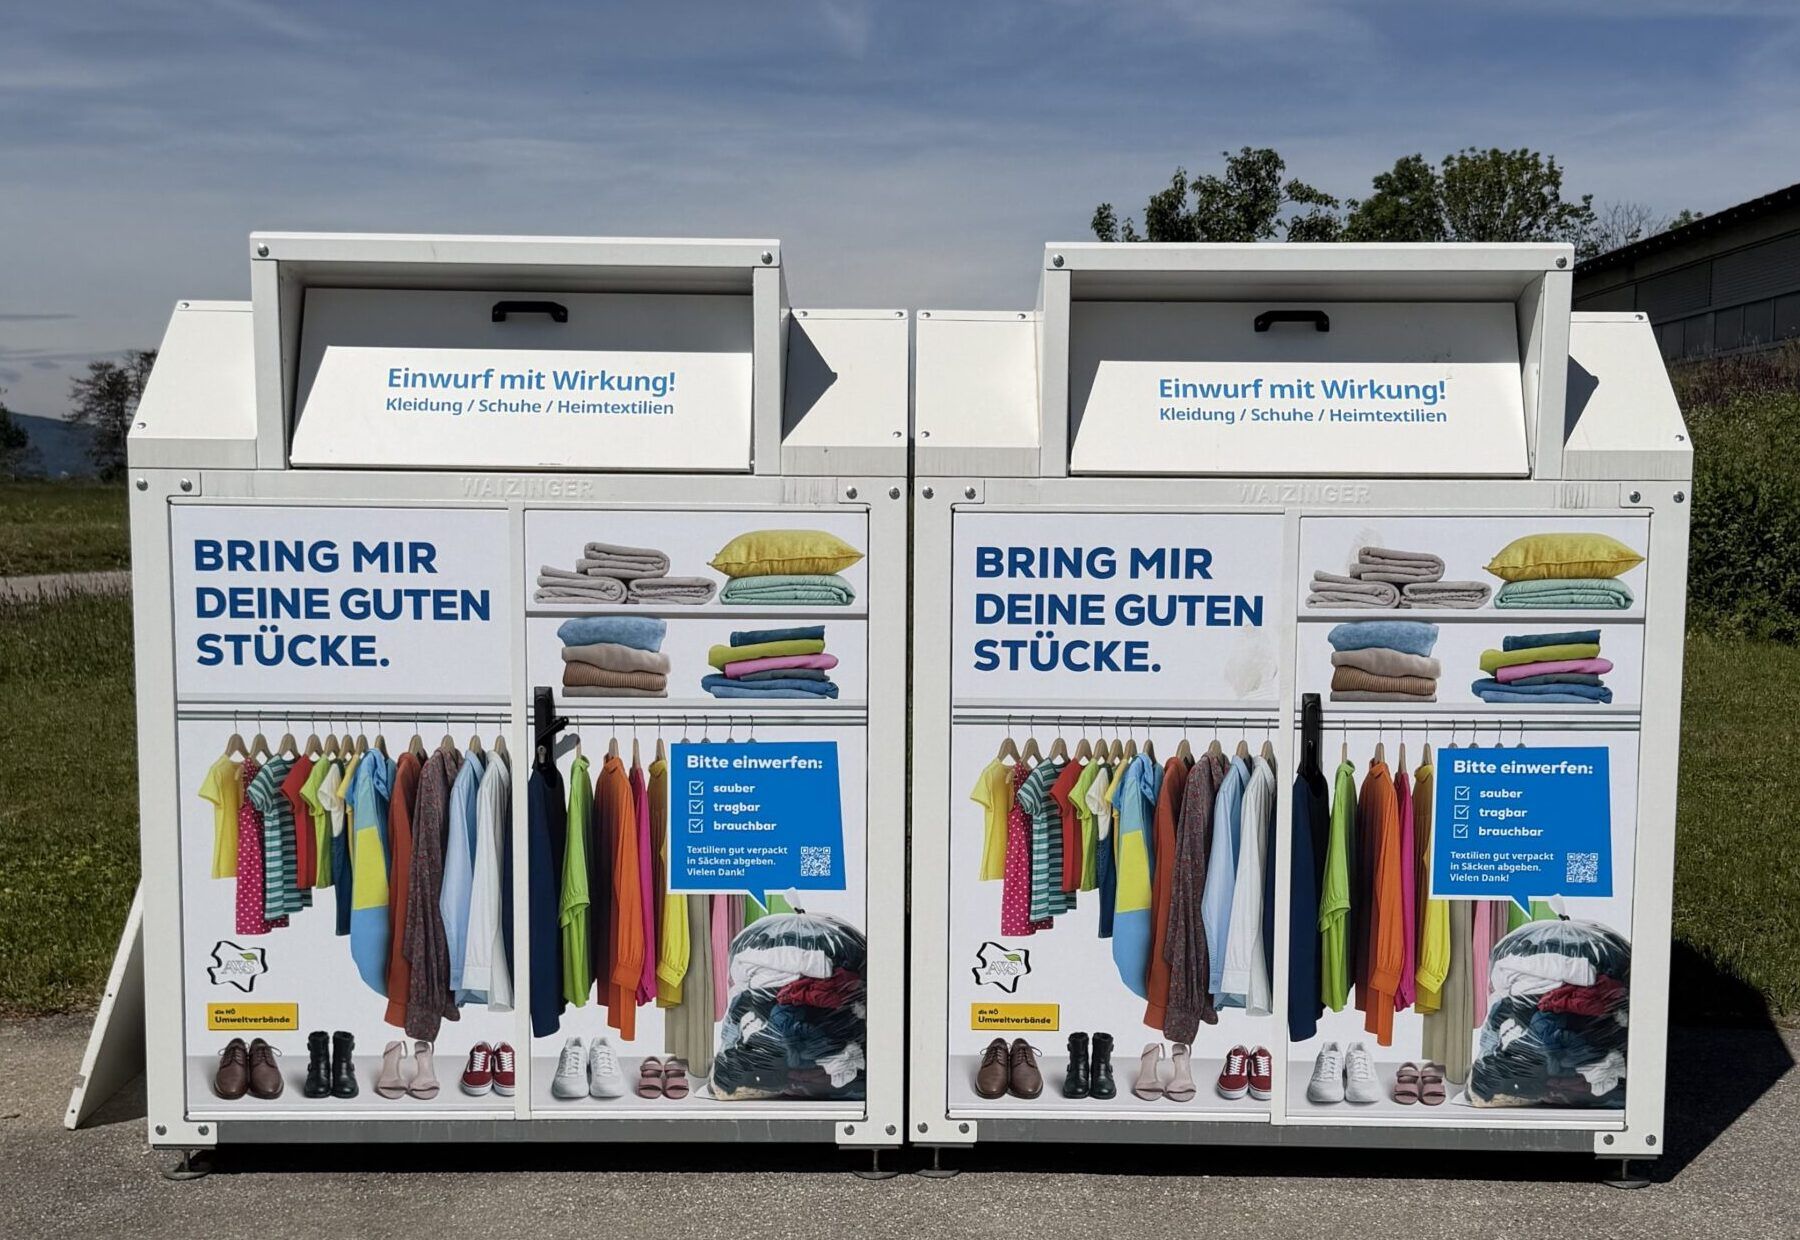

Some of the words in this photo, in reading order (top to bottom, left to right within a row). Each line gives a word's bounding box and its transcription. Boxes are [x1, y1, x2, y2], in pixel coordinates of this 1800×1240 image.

[388, 368, 495, 389] Einwurf
[500, 369, 545, 390] mit
[553, 370, 676, 397] Wirkung!
[1159, 378, 1263, 399] Einwurf
[1270, 379, 1315, 400] mit
[1321, 379, 1446, 405] Wirkung!
[386, 398, 463, 416] Kleidung
[478, 399, 542, 413] Schuhe
[557, 400, 674, 415] Heimtextilien
[1159, 407, 1236, 425] Kleidung
[1251, 408, 1314, 422] Schuhe
[1330, 409, 1447, 423] Heimtextilien
[459, 477, 594, 498] WAIZINGER
[1237, 483, 1371, 504] WAIZINGER
[194, 539, 339, 573] BRING
[353, 541, 438, 573] MIR
[976, 546, 1117, 579] BRING
[1130, 547, 1213, 579] MIR
[196, 587, 330, 620] DEINE
[339, 587, 490, 621] GUTEN
[975, 593, 1106, 625] DEINE
[1114, 594, 1264, 627] GUTEN
[196, 625, 390, 667] STÜCKE.
[973, 630, 1161, 673] STÜCKE.
[686, 754, 729, 769] Bitte
[732, 755, 823, 769] einwerfen:
[1453, 759, 1497, 774] Bitte
[1500, 760, 1594, 775] einwerfen:
[713, 783, 756, 794] sauber
[1479, 788, 1523, 799] sauber
[713, 802, 761, 815] tragbar
[1478, 807, 1528, 820] tragbar
[713, 820, 778, 831] brauchbar
[1478, 826, 1544, 837] brauchbar
[686, 845, 727, 854] Textilien
[728, 847, 745, 856] gut
[746, 846, 788, 856] verpackt
[1450, 851, 1491, 860] Textilien
[1493, 852, 1510, 862] gut
[1511, 852, 1555, 862] verpackt
[686, 857, 696, 866] in
[698, 857, 731, 866] Säcken
[733, 857, 776, 867] abgeben.
[1450, 862, 1460, 871] in
[1461, 862, 1495, 871] Säcken
[1497, 862, 1542, 872] abgeben.
[686, 868, 716, 877] Vielen
[718, 868, 745, 877] Dank!
[1449, 873, 1479, 882] Vielen
[1481, 873, 1509, 882] Dank!
[214, 1016, 291, 1024] Umweltverbände
[977, 1016, 1052, 1025] Umweltverbände
